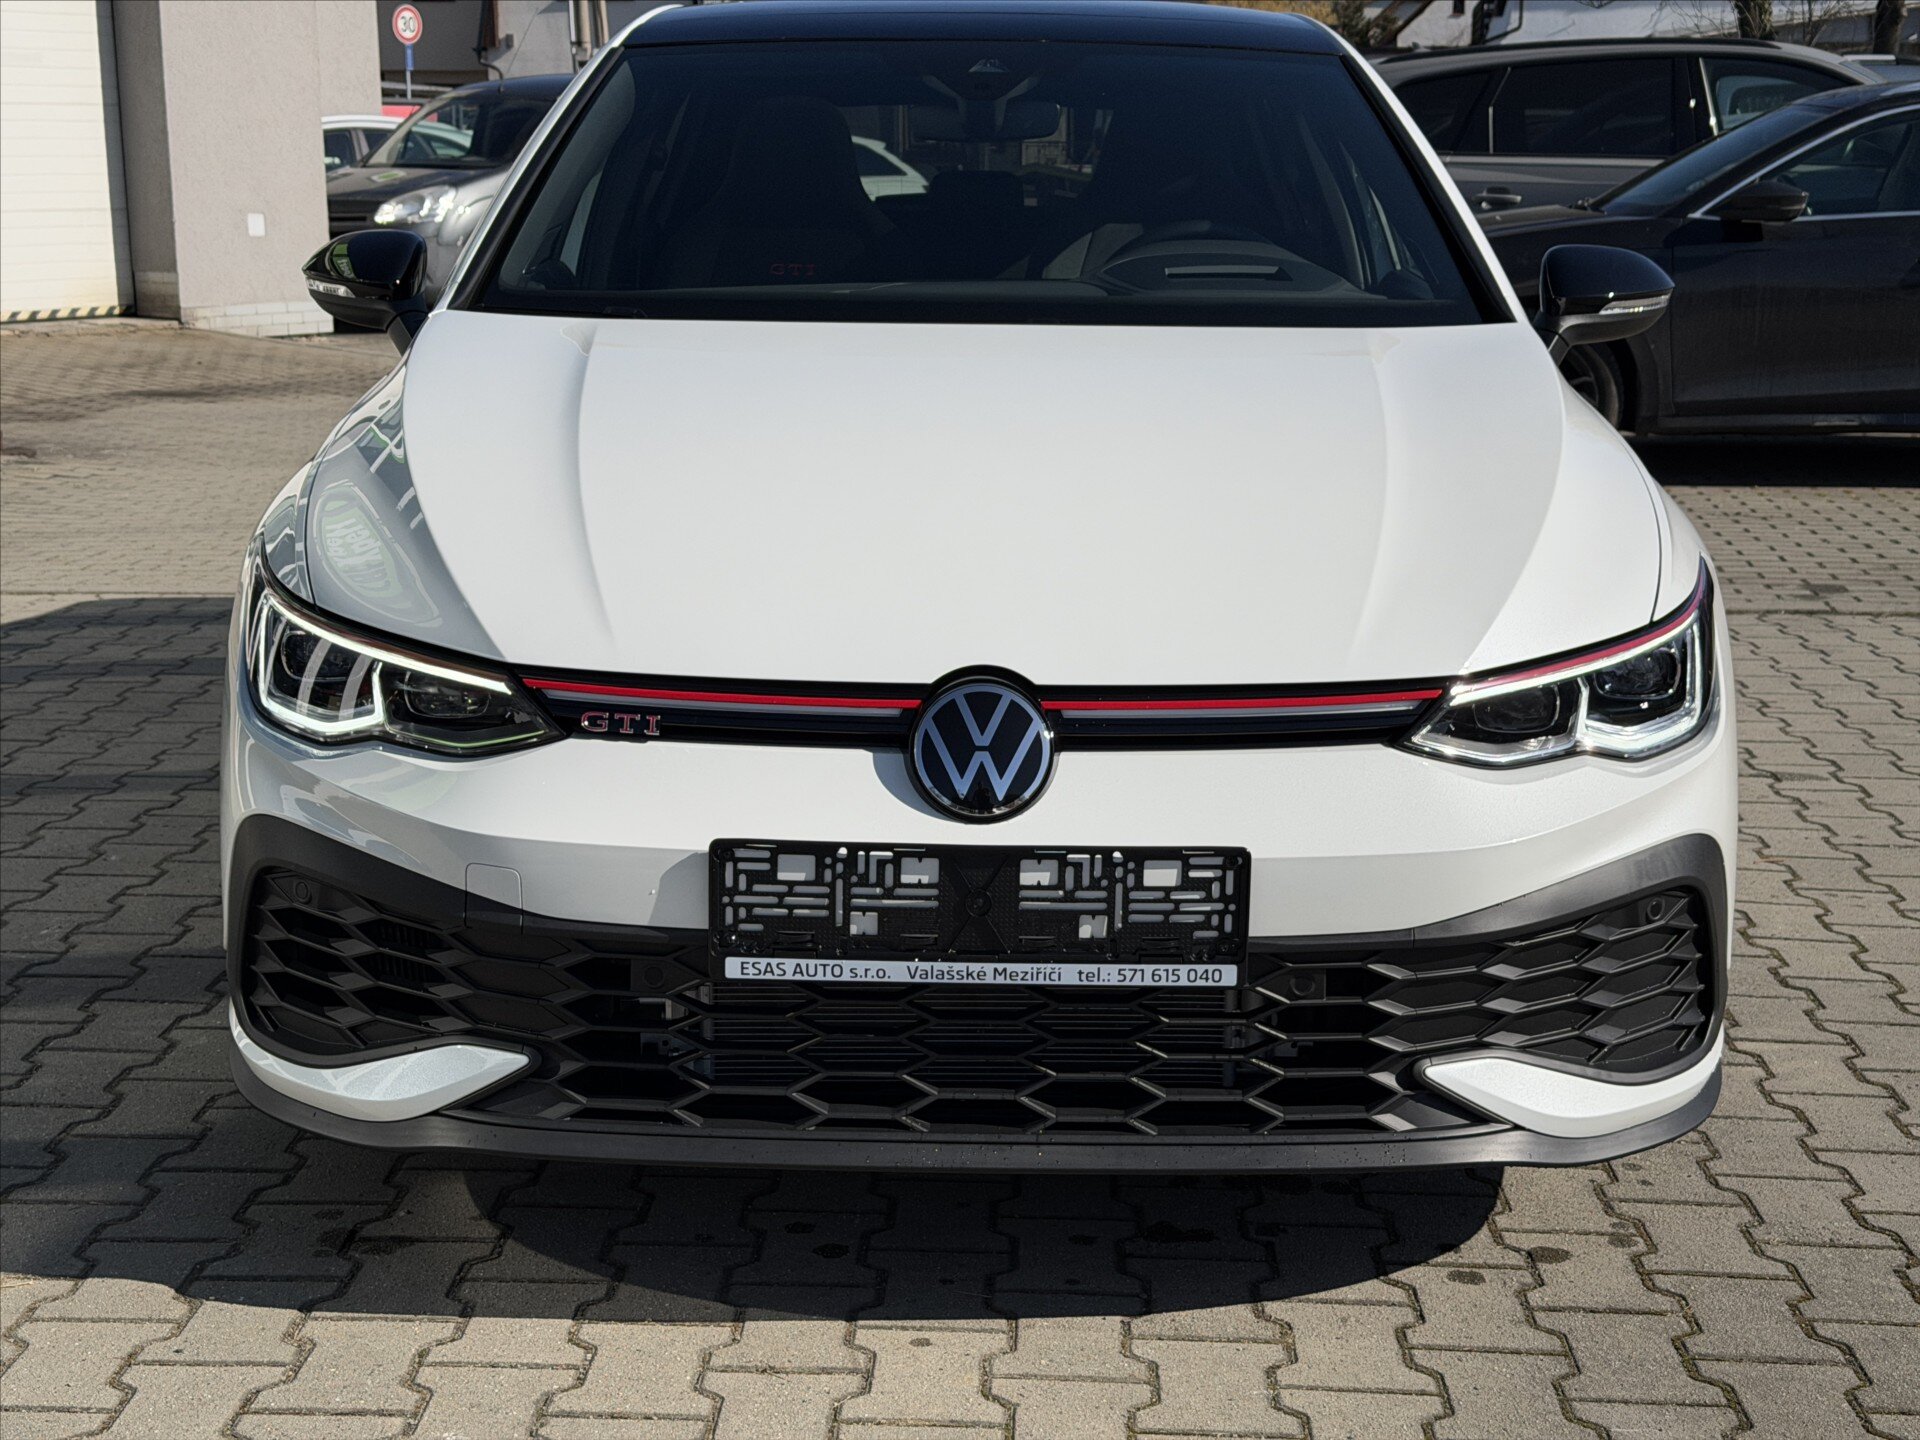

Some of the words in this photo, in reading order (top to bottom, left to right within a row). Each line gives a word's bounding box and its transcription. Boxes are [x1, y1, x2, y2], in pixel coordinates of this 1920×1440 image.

[400, 15, 416, 33] 30
[770, 263, 816, 276] GTI
[581, 711, 661, 736] GTI
[920, 686, 1046, 806] VW
[740, 961, 787, 977] ESAS
[792, 962, 844, 978] AUTO
[849, 966, 892, 979] s.r.o.
[906, 964, 987, 981] Valašské
[993, 966, 1062, 982] Meziříčí
[1077, 967, 1111, 983] tel.:
[1117, 968, 1145, 983] 571
[1151, 968, 1181, 983] 615
[1186, 968, 1223, 983] 040
